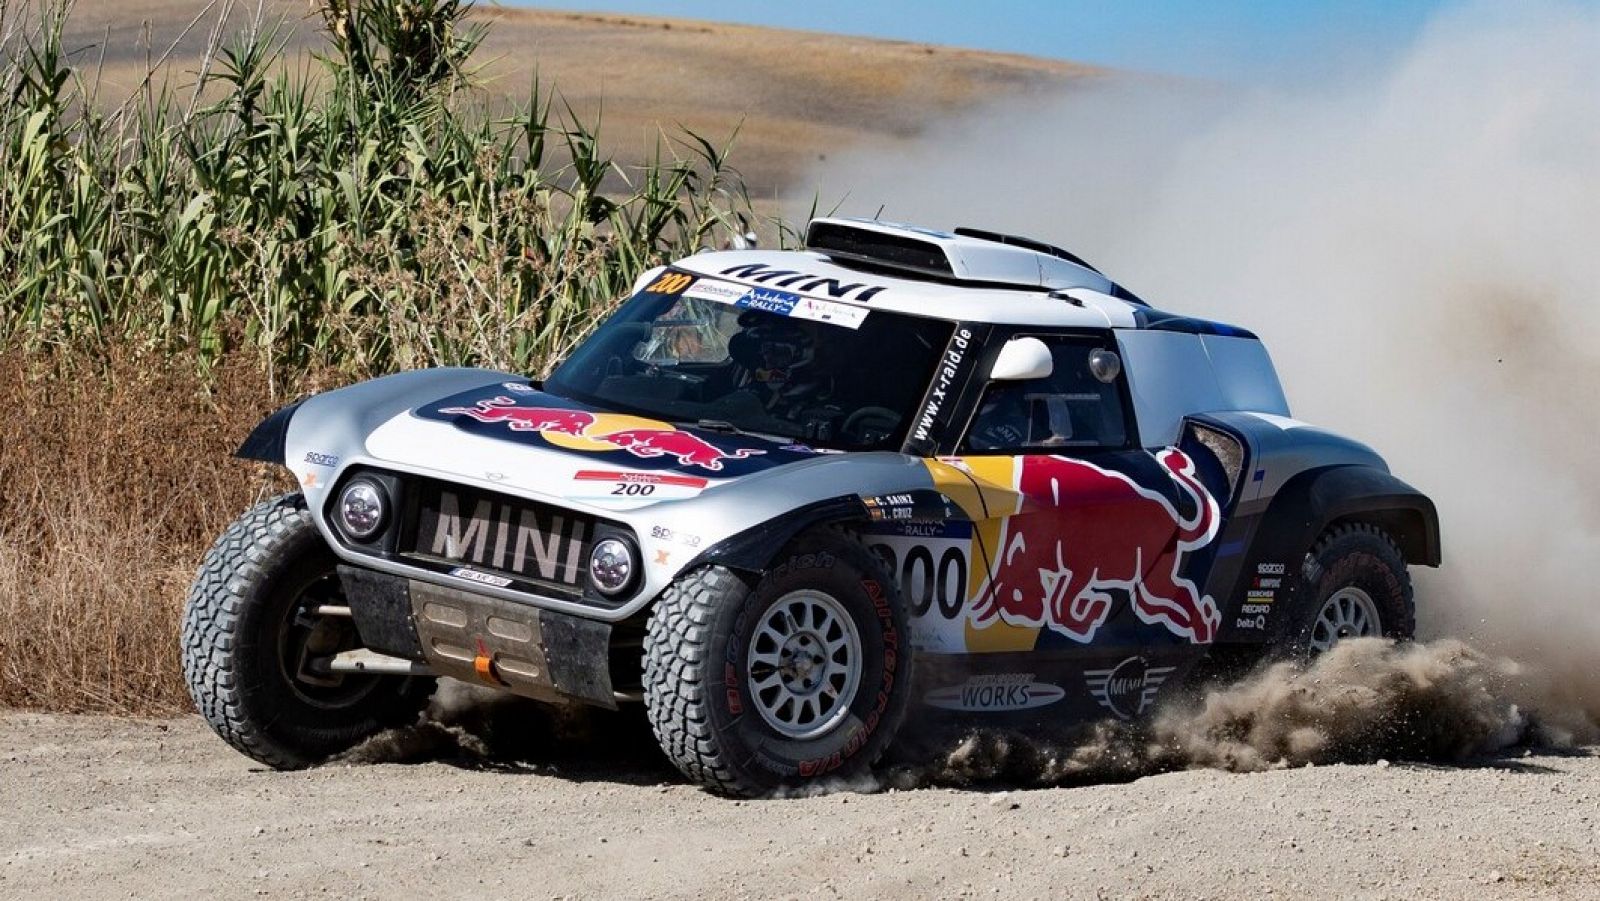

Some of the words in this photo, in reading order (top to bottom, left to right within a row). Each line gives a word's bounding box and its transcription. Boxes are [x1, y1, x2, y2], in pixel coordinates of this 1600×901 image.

[646, 272, 692, 295] 200
[718, 263, 888, 302] MINI
[914, 329, 972, 441] www.x-raid.de
[611, 483, 656, 496] 200
[431, 491, 585, 584] MINI
[905, 525, 936, 536] RALLY
[1241, 604, 1271, 614] RECARO
[961, 684, 1031, 707] WORKS
